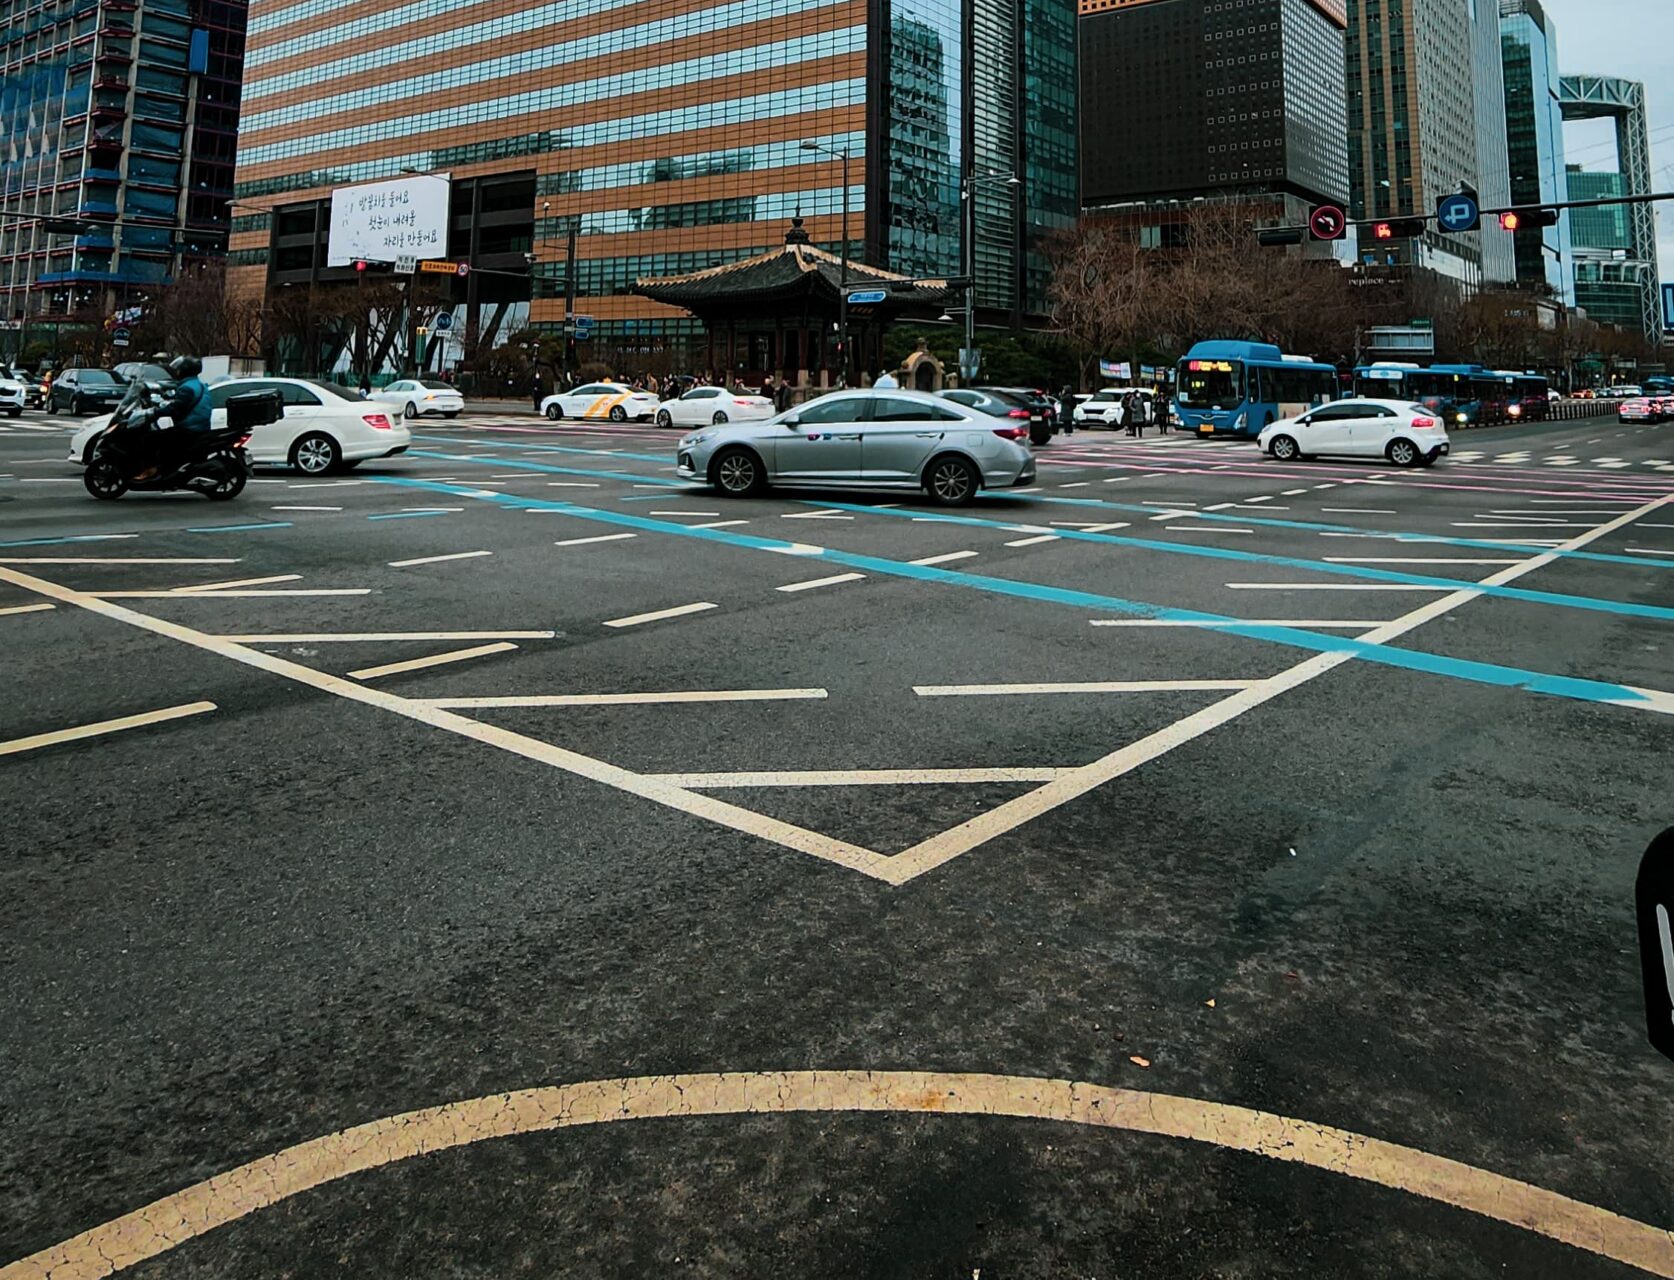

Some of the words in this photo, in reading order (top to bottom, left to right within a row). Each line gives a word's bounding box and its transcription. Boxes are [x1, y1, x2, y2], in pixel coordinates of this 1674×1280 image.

[389, 190, 409, 207] 들어요
[384, 232, 404, 248] 자리를
[407, 229, 437, 246] 만들어요
